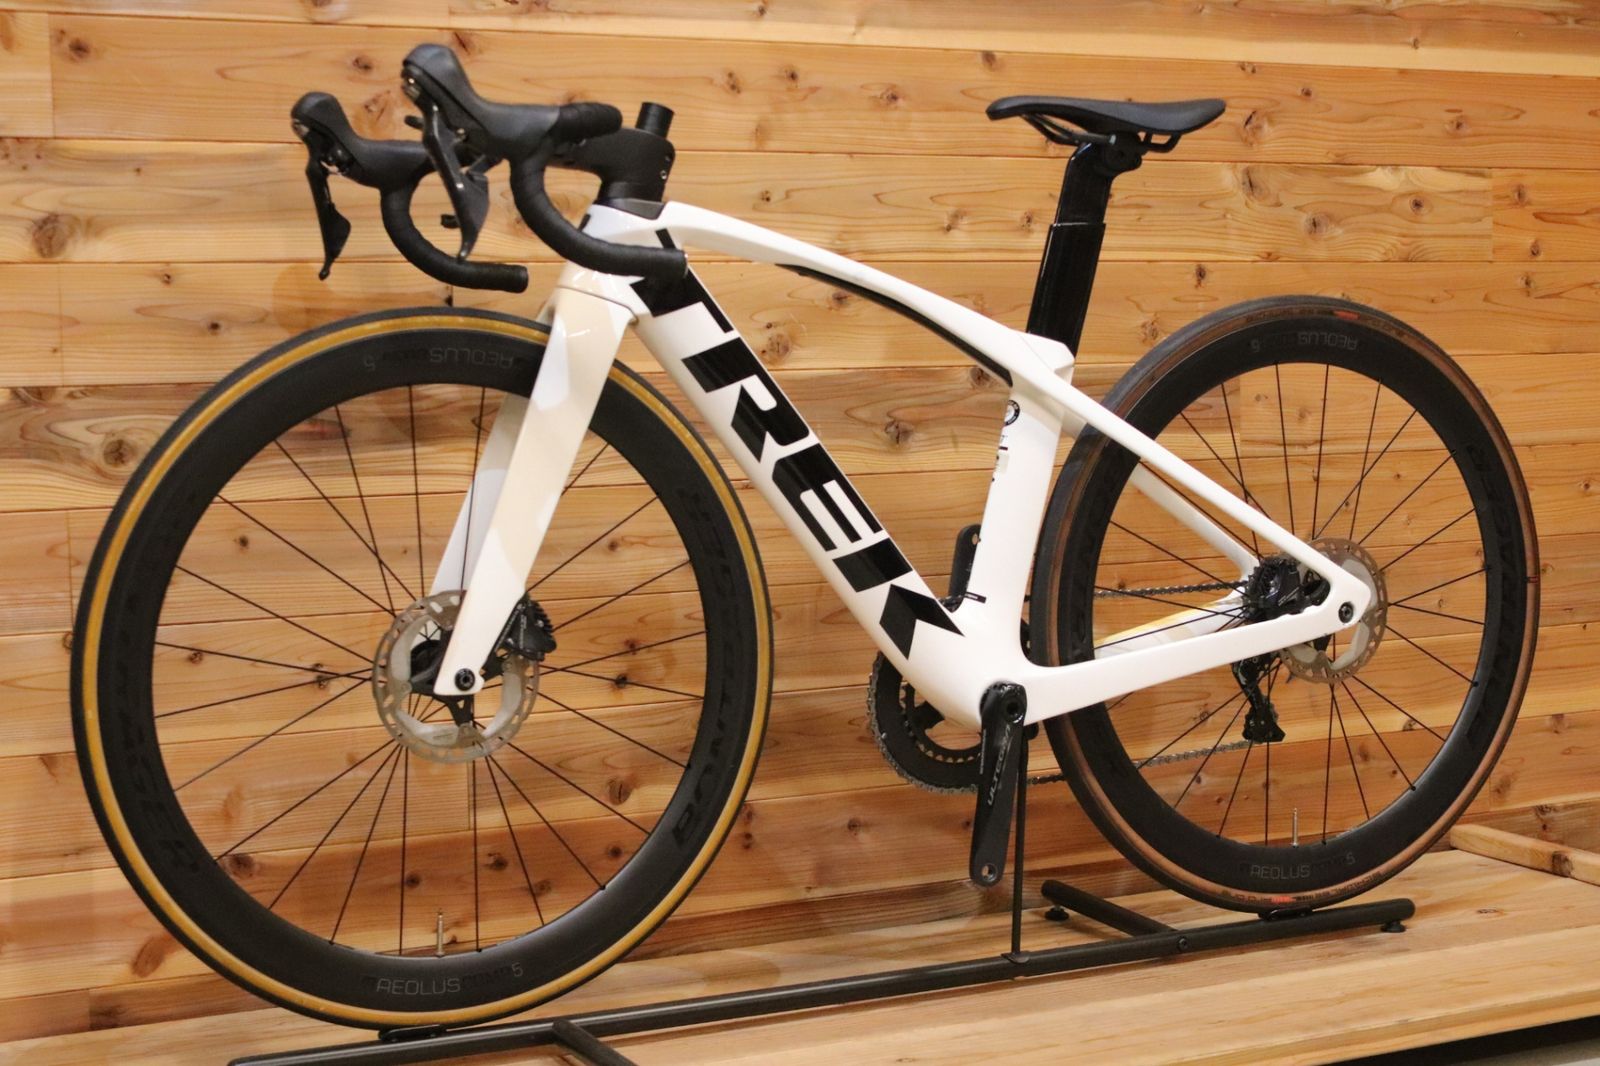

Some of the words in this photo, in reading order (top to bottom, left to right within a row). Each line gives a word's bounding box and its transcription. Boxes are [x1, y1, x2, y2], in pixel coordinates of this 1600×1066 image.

[1298, 331, 1359, 350] AEOLUS
[363, 355, 377, 371] 5
[429, 347, 514, 369] AEOLUS
[630, 228, 965, 660] TREK
[1250, 864, 1311, 880] AEOLUS
[1345, 852, 1356, 865] 5
[376, 978, 461, 995] AEOLUS
[511, 962, 524, 977] 5
